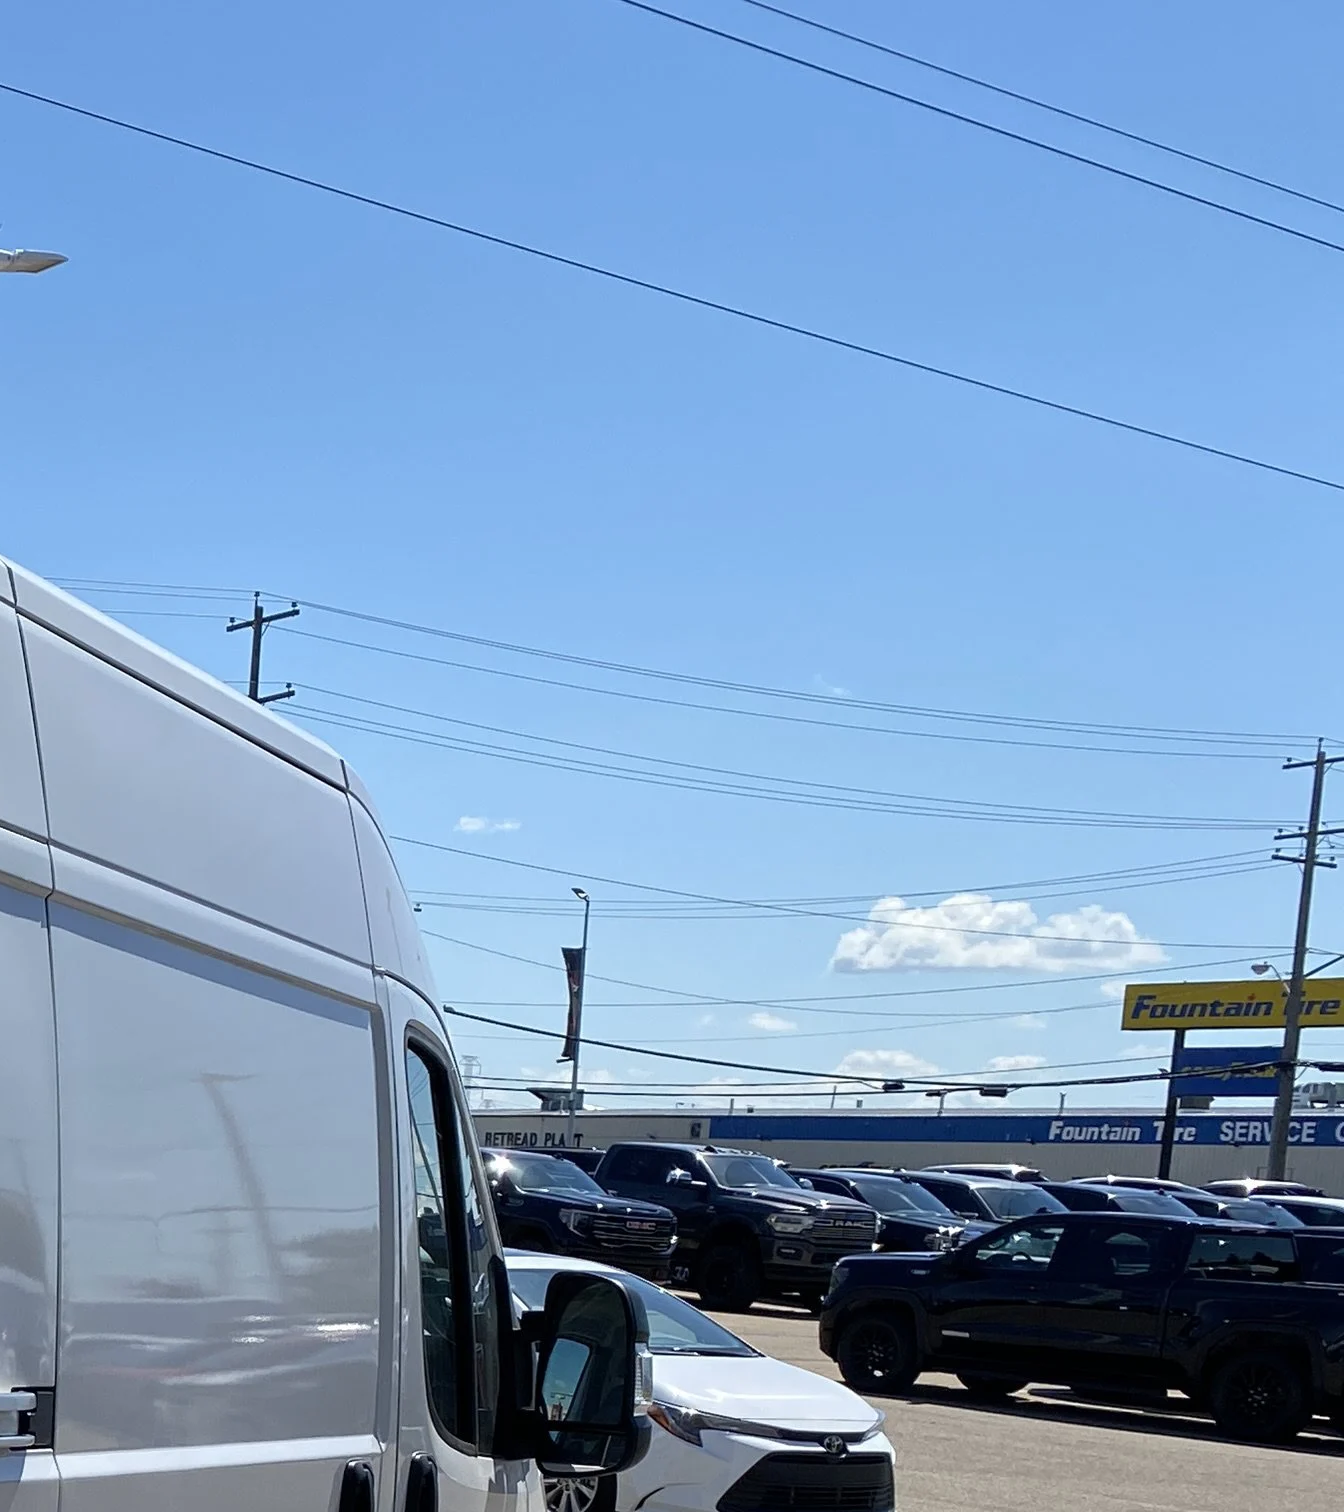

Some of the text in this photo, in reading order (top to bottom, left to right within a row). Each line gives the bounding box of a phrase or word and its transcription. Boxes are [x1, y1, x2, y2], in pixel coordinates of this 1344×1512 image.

[1131, 993, 1273, 1019] Fountain
[484, 1132, 584, 1148] RETREAD PLAT
[1048, 1119, 1141, 1141] Fountain
[1153, 1120, 1197, 1142] Tre
[1219, 1121, 1317, 1142] SERVCE
